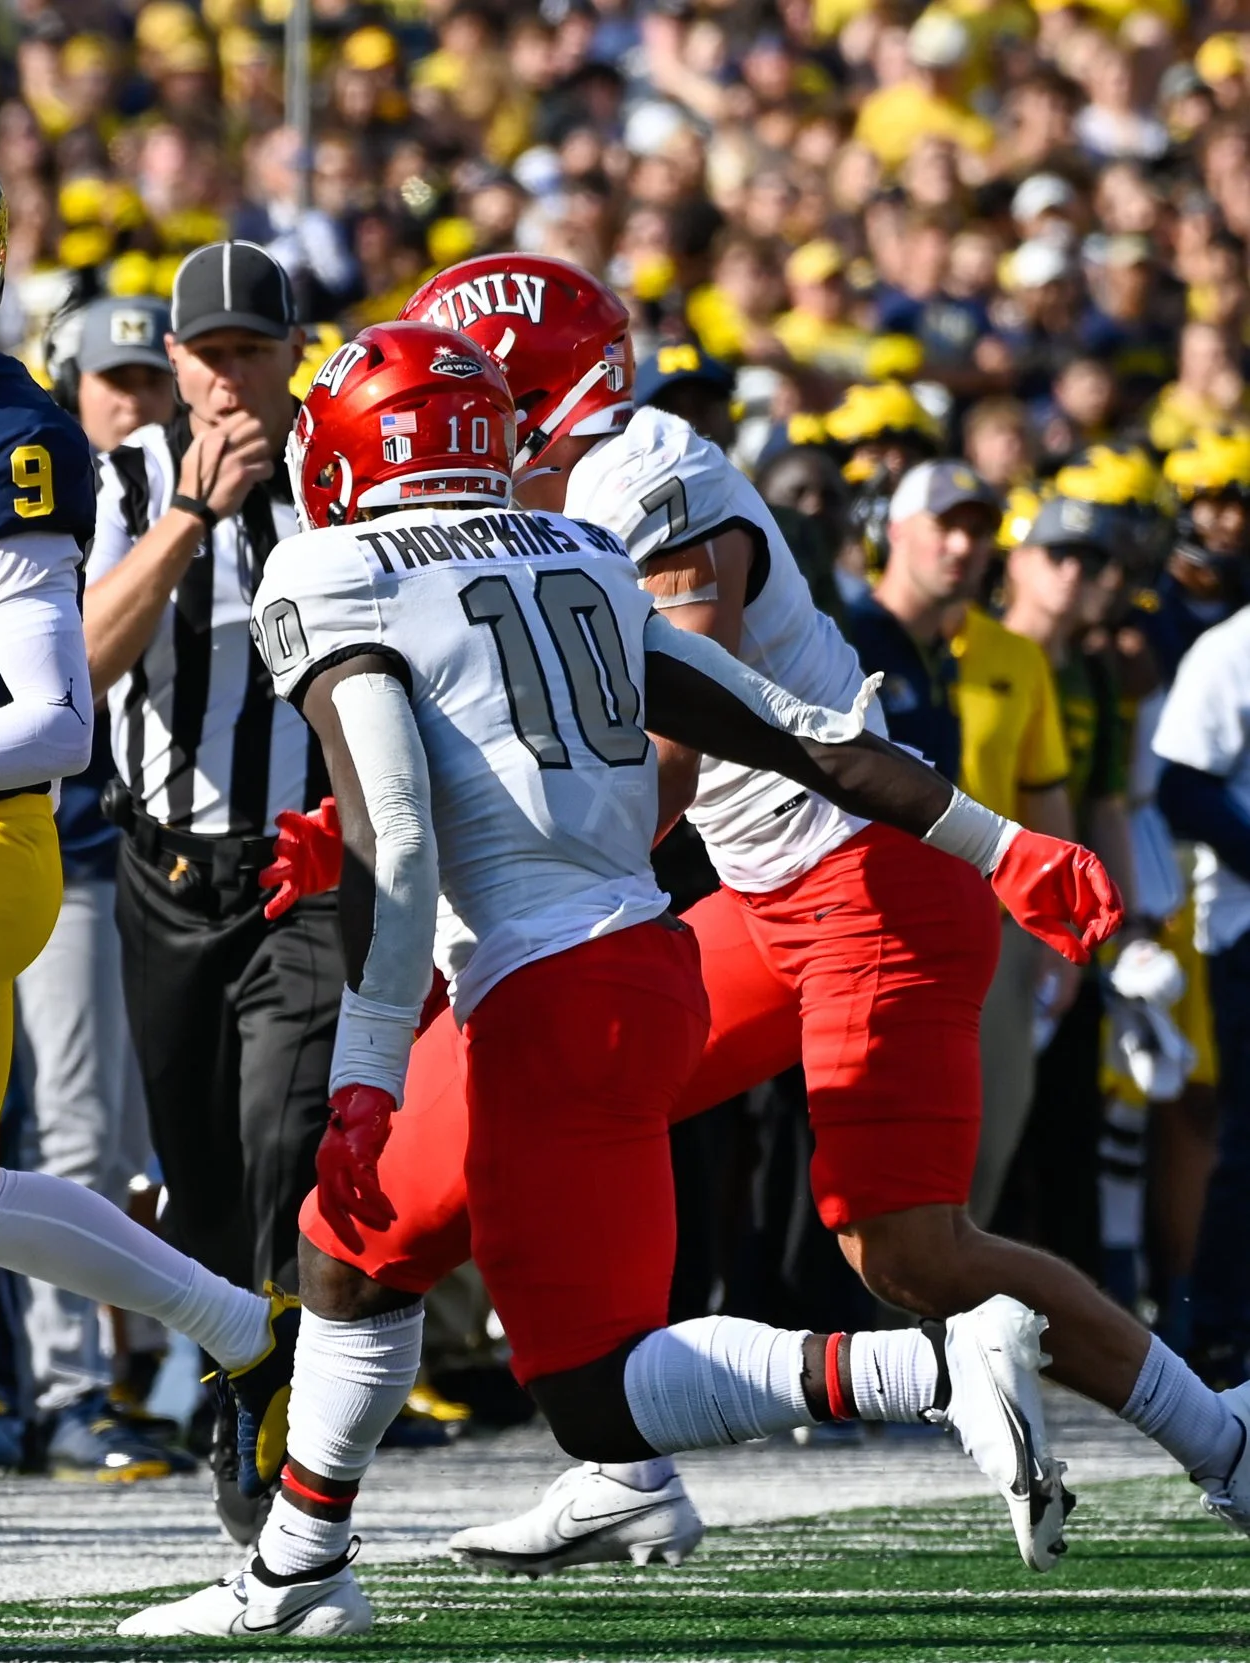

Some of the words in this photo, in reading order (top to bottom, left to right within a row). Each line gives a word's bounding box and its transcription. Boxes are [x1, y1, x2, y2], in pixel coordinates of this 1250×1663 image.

[437, 364, 453, 372] LAS
[453, 364, 478, 372] VEGAS
[447, 416, 489, 454] 10
[10, 445, 54, 518] 9
[400, 476, 507, 499] REBELS
[638, 475, 688, 542] 7
[356, 512, 581, 574] THOMPKINS
[458, 568, 650, 770] 10
